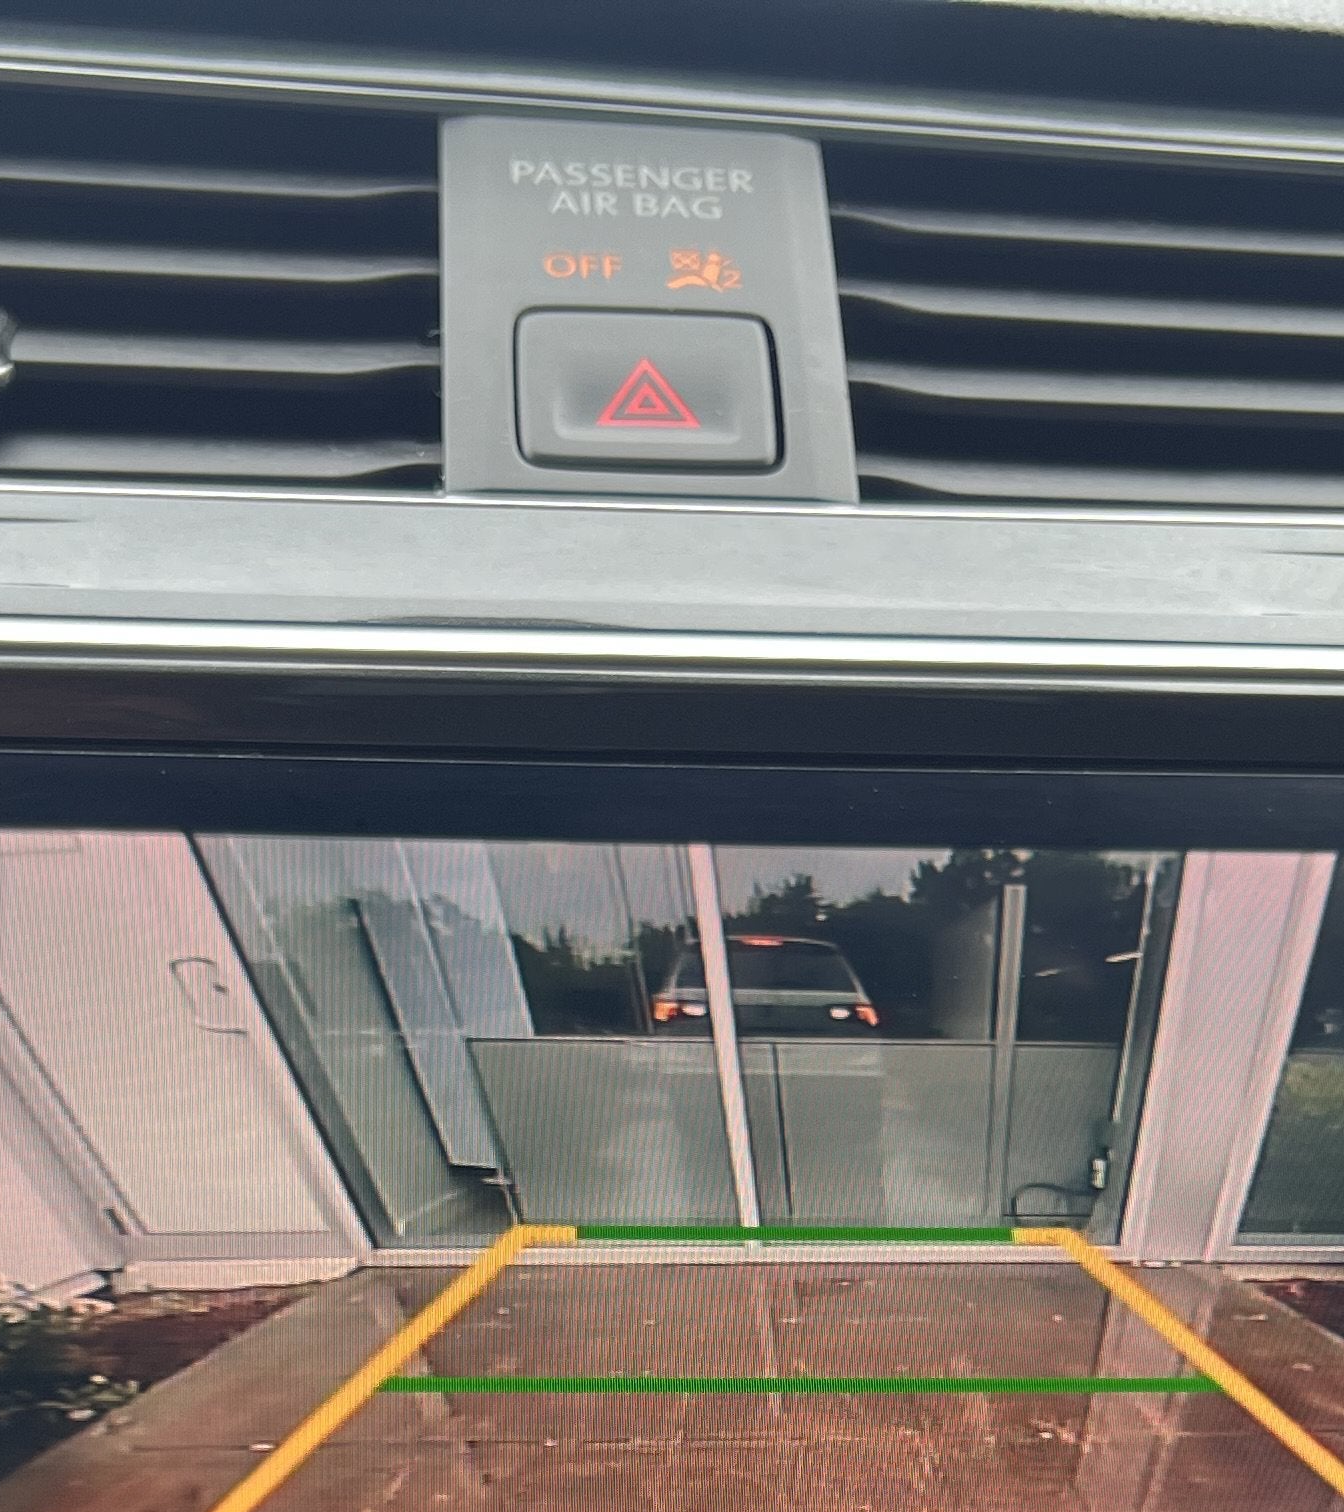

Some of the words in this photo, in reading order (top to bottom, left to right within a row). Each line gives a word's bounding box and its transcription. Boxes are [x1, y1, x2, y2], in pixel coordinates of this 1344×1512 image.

[509, 159, 754, 194] PASSENGER
[551, 193, 619, 217] AIR
[632, 194, 724, 221] BAG
[543, 251, 623, 280] OFF
